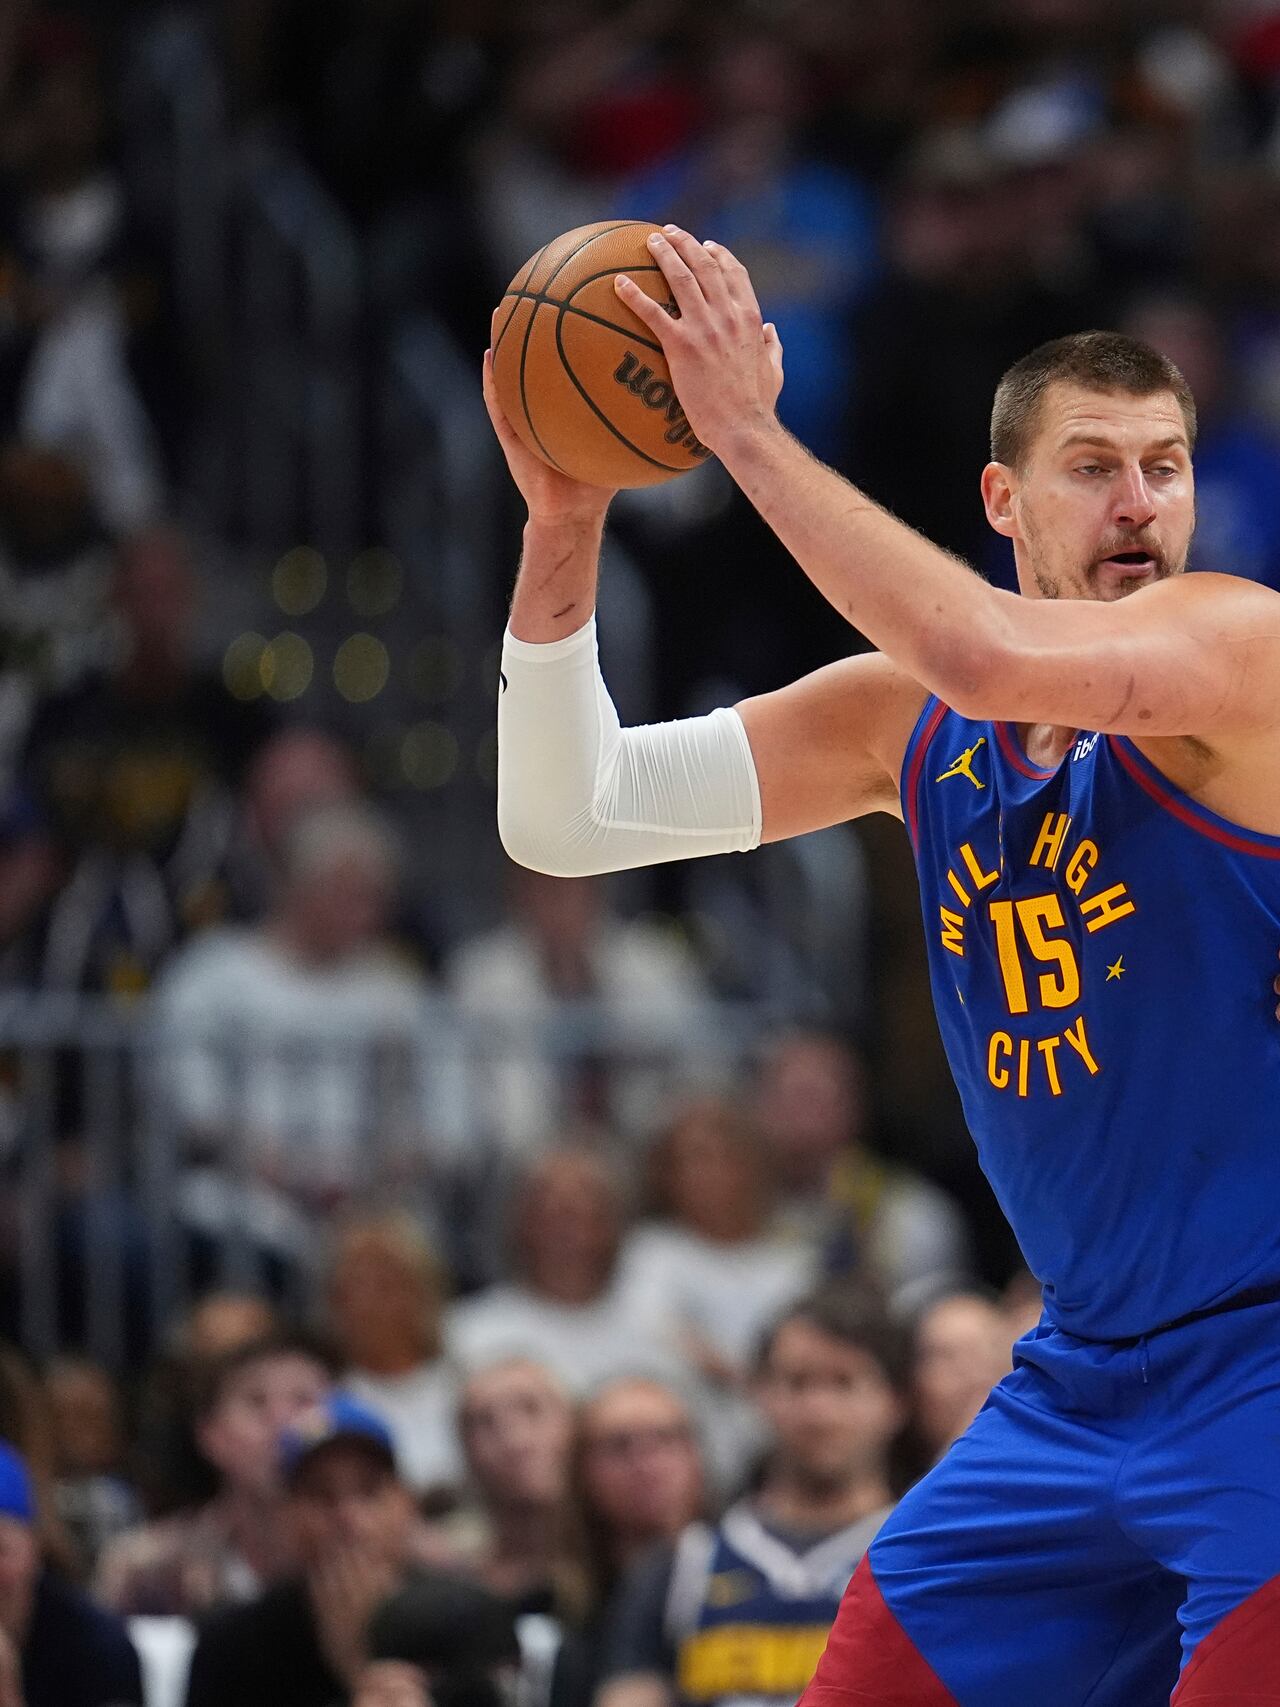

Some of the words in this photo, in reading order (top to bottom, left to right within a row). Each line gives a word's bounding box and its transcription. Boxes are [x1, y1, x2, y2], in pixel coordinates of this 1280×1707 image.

[939, 820, 1004, 957] MIL
[988, 892, 1081, 1015] 15
[987, 1015, 1100, 1097] CITY
